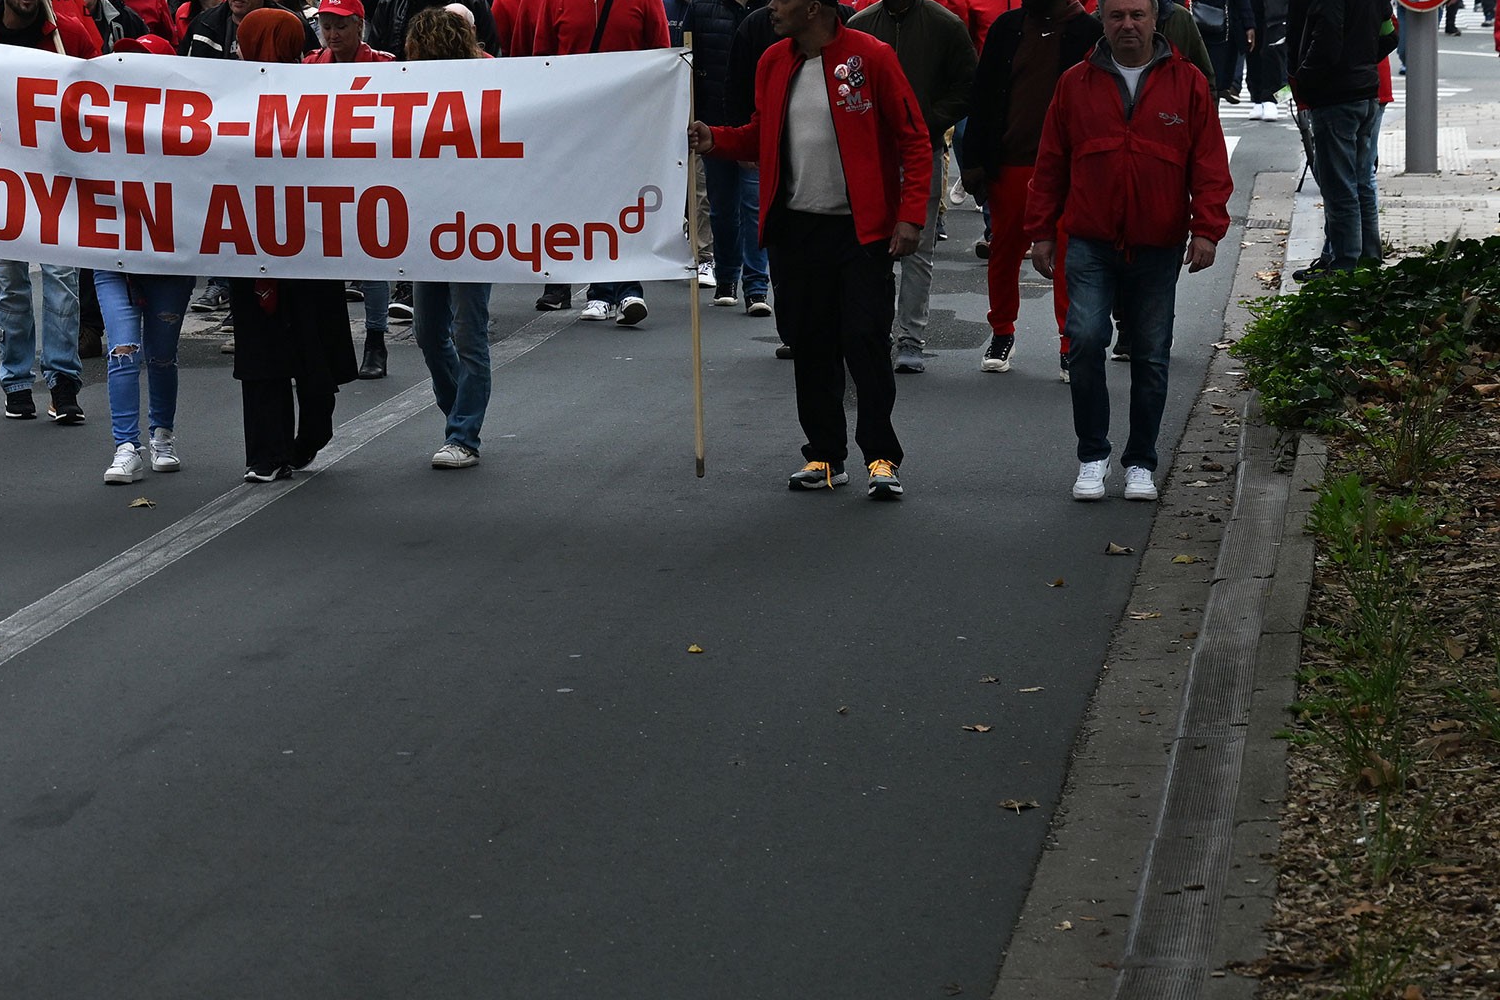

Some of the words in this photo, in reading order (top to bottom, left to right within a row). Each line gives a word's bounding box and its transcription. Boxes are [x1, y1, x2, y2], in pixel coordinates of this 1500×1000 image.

[16, 76, 524, 159] FGTB-MÉTAL
[200, 184, 408, 259] AUTO
[429, 211, 619, 273] doyen
